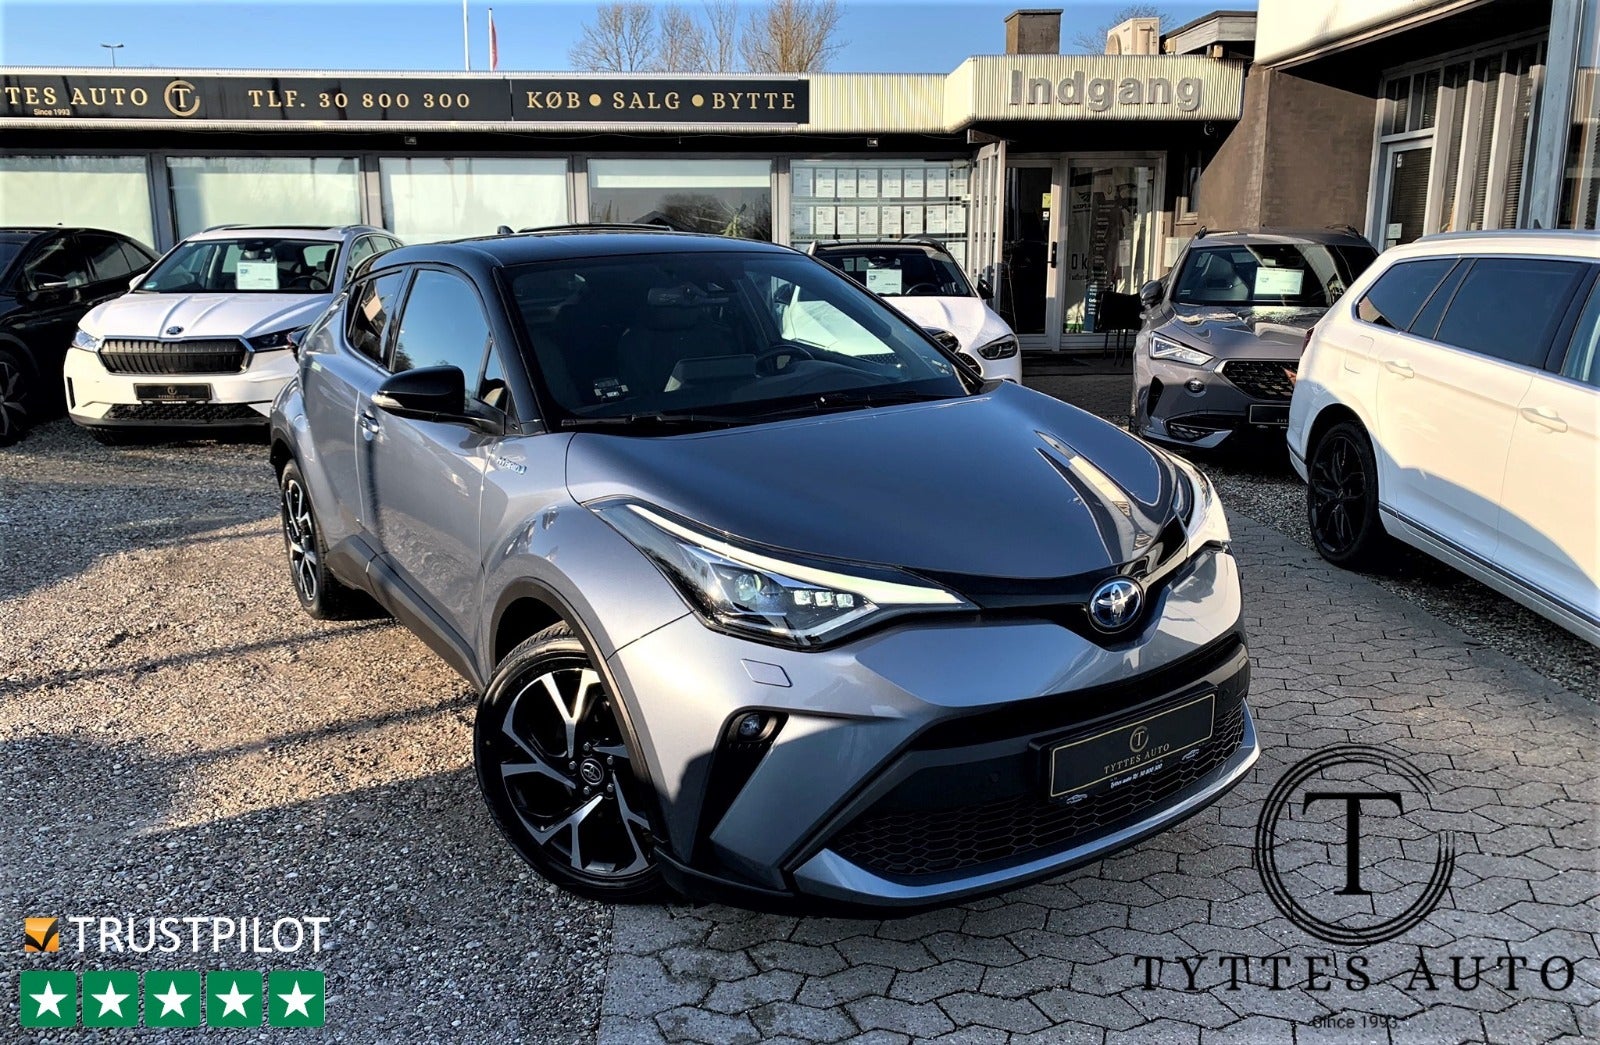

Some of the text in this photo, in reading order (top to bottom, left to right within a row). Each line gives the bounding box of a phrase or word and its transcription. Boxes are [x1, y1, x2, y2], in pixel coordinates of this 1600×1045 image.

[0, 87, 148, 106] TES AUTO
[248, 90, 470, 108] TLF. 30 800 300
[1010, 69, 1202, 112] Indgang
[526, 91, 796, 110] KØB SALG BYTTE
[33, 108, 71, 116] Since 1993
[1104, 743, 1170, 774] TYTTES AUTO
